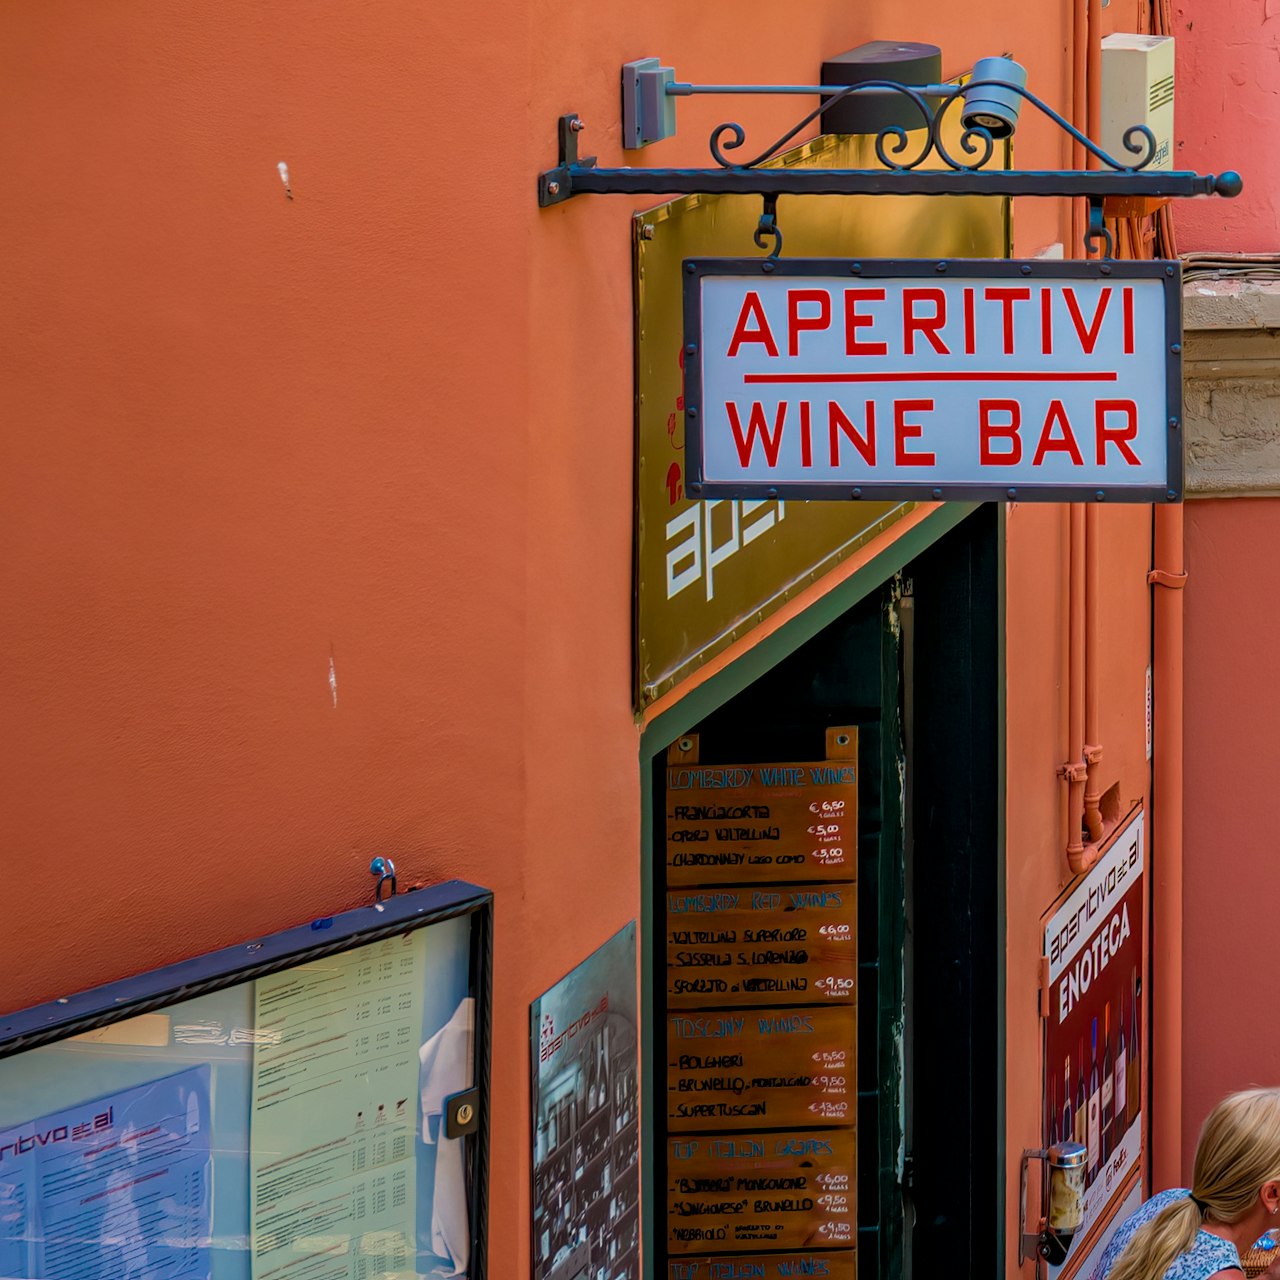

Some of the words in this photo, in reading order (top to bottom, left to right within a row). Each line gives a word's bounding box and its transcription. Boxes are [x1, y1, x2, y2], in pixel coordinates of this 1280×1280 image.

[727, 287, 1135, 358] APERITIVI
[725, 399, 937, 469] WINE
[978, 398, 1143, 467] BAR
[759, 767, 807, 787] WHITE
[809, 766, 857, 785] WINES
[1058, 901, 1132, 1026] ENOTECA
